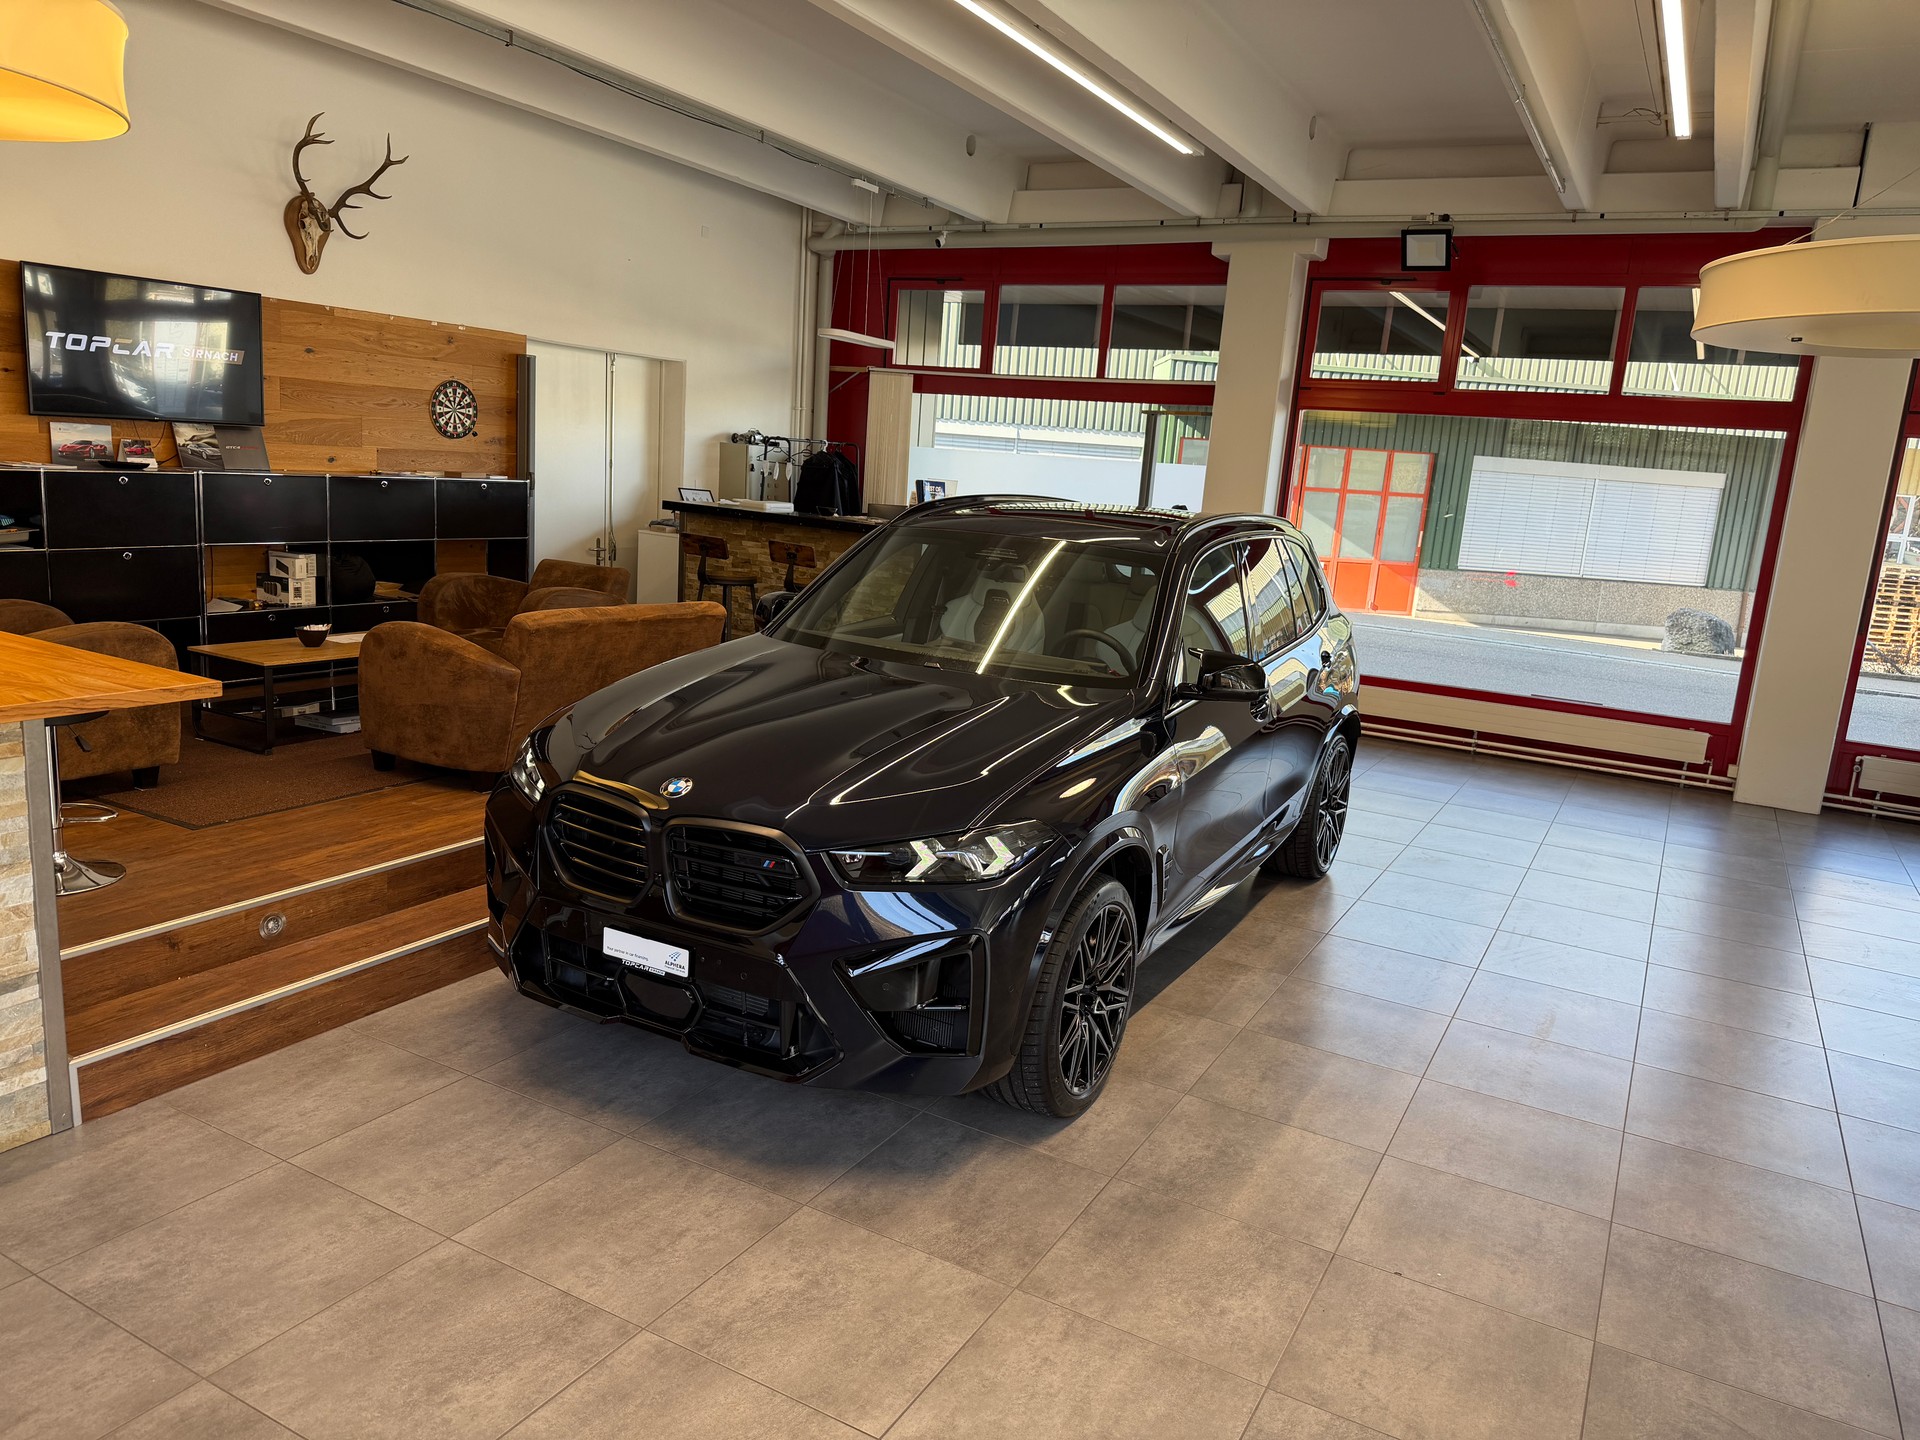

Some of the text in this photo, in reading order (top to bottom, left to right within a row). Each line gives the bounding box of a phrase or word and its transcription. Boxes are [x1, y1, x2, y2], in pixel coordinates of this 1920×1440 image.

[45, 331, 239, 362] TOPCAR SIRNACH
[621, 959, 650, 972] TOPCAR
[664, 960, 686, 970] ALPHERA
